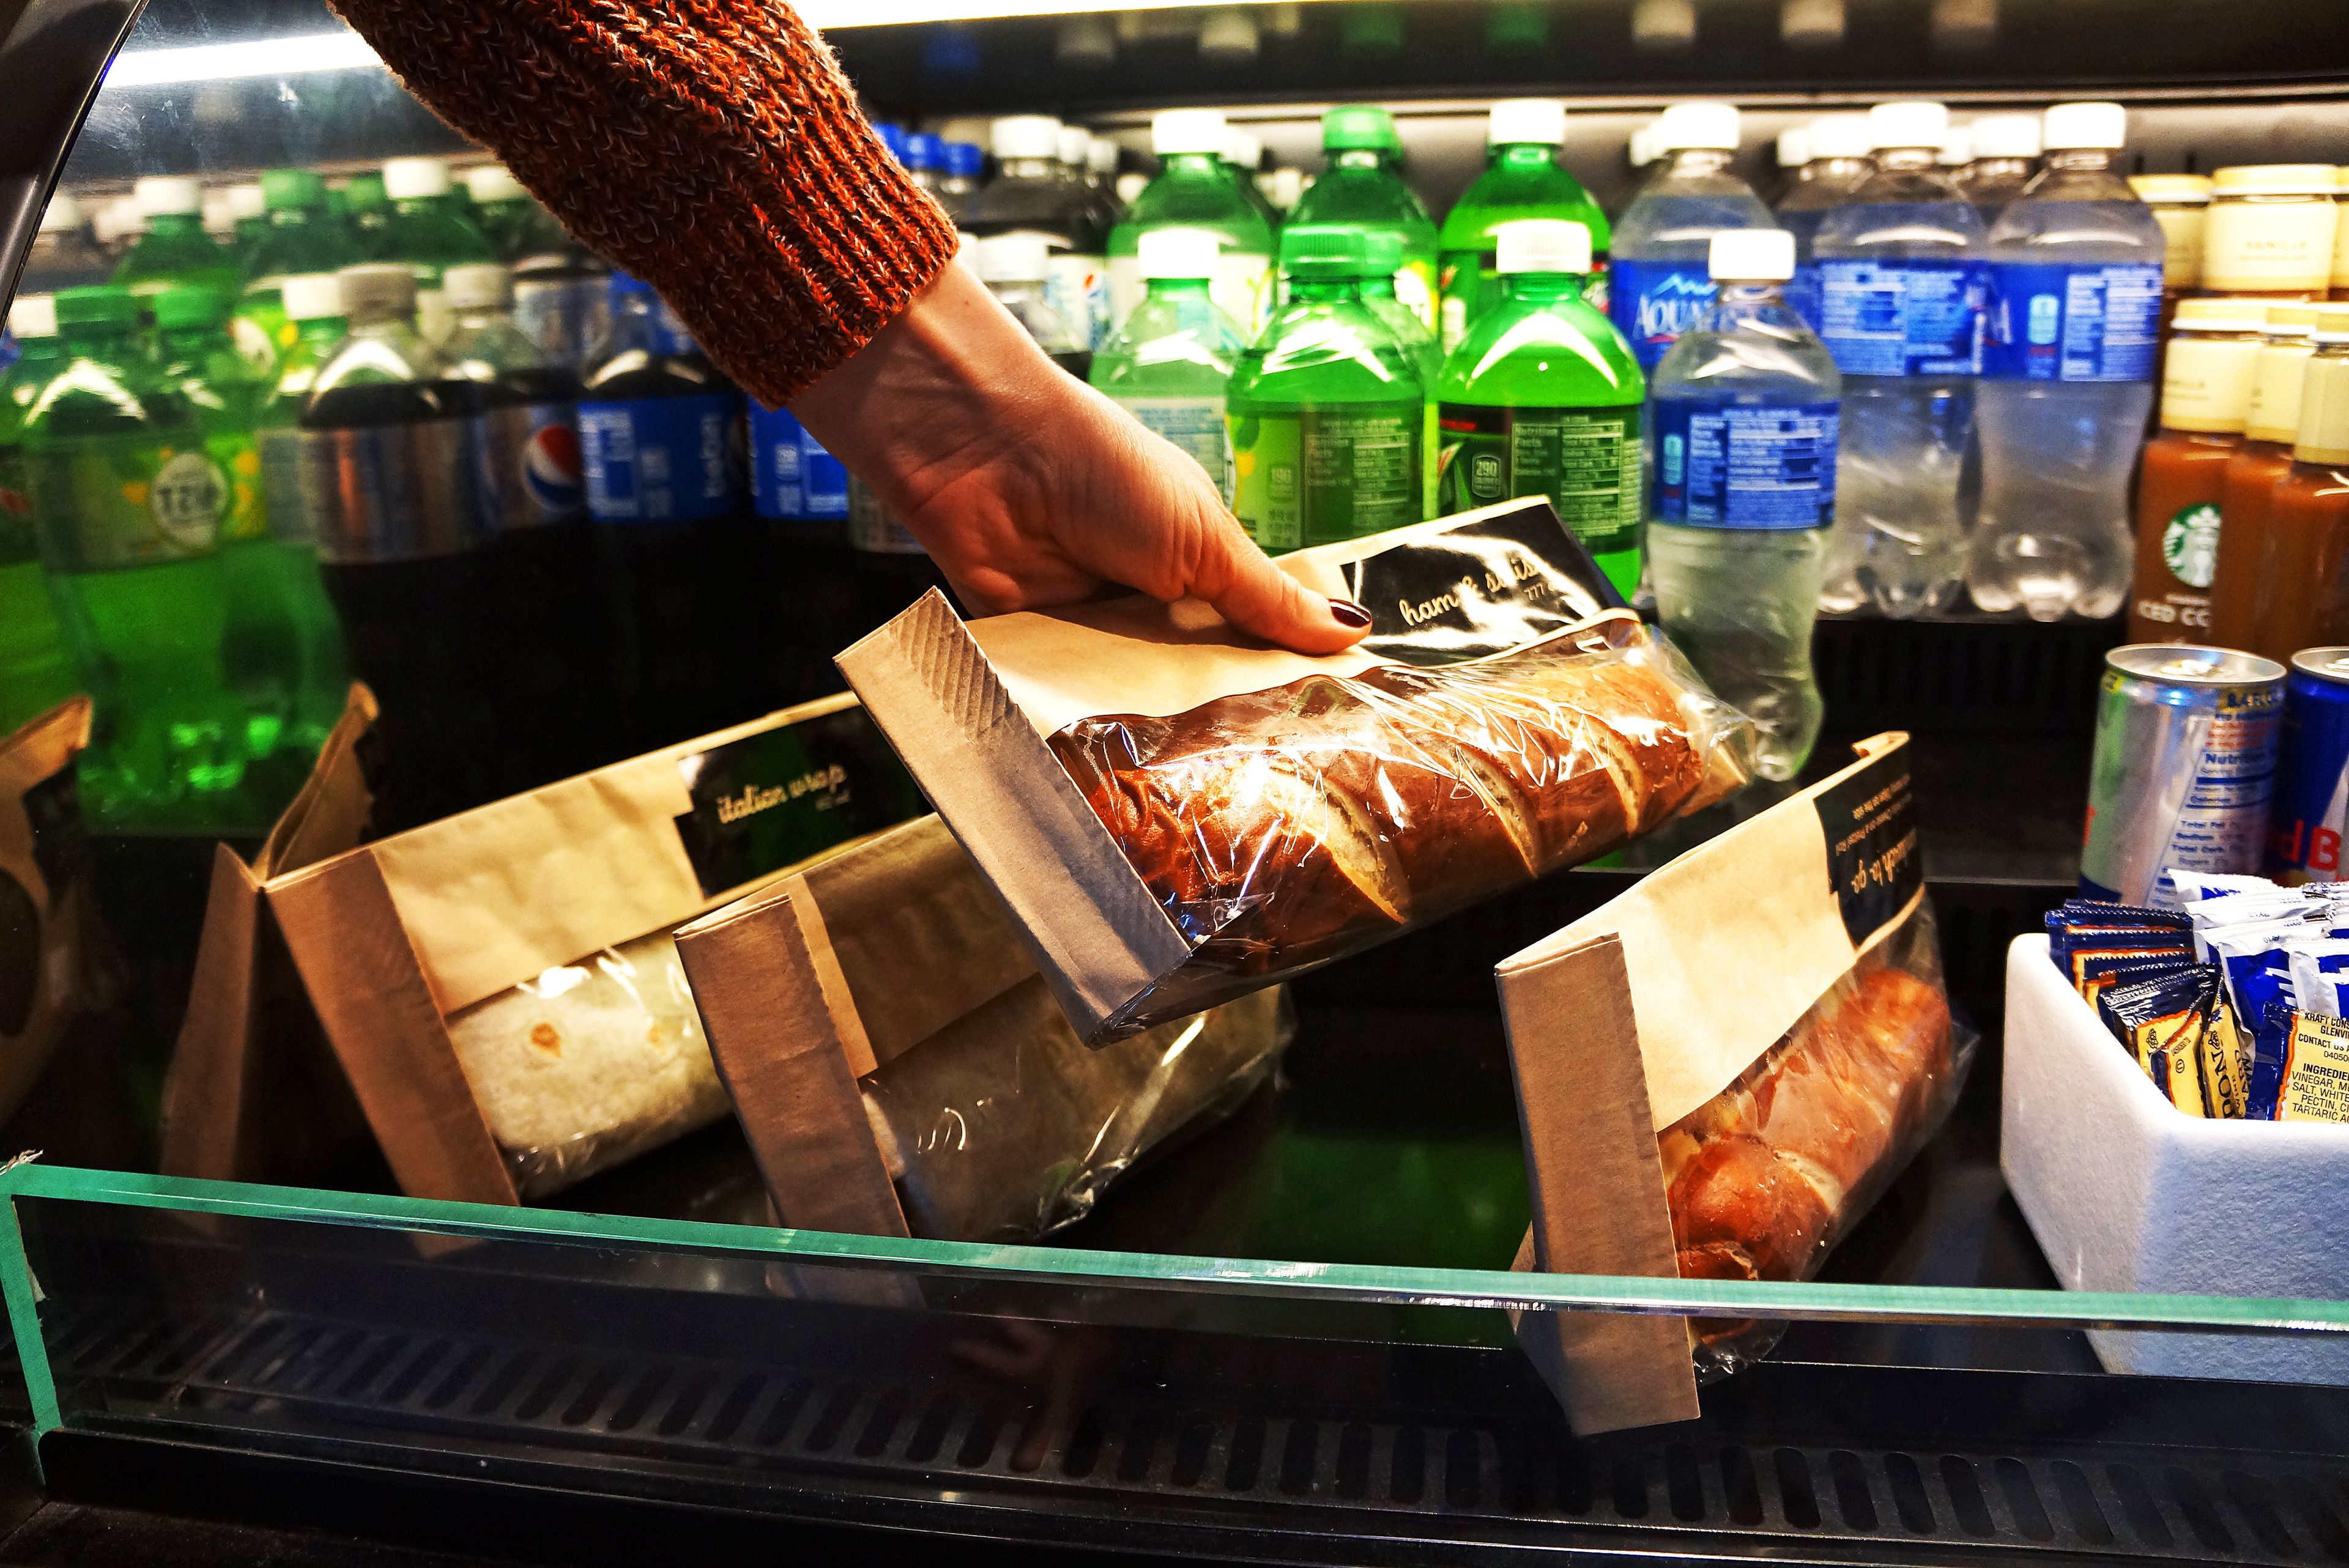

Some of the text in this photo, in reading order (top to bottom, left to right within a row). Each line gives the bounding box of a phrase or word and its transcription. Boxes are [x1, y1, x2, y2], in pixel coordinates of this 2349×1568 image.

[1398, 593, 1459, 626] ham
[716, 783, 789, 824] italian
[788, 764, 847, 798] wrap
[2304, 1011, 2329, 1025] KRAFT
[2298, 1033, 2331, 1048] CONTACT
[2320, 1025, 2349, 1040] GLENVI
[2324, 1050, 2349, 1063] 04050
[2303, 1062, 2349, 1081] INGREDIE
[2291, 1071, 2335, 1090] VINEGAR,
[2292, 1081, 2317, 1096] SALT,
[2301, 1094, 2337, 1111] PECTIN,
[2292, 1102, 2338, 1121] TARTARIC
